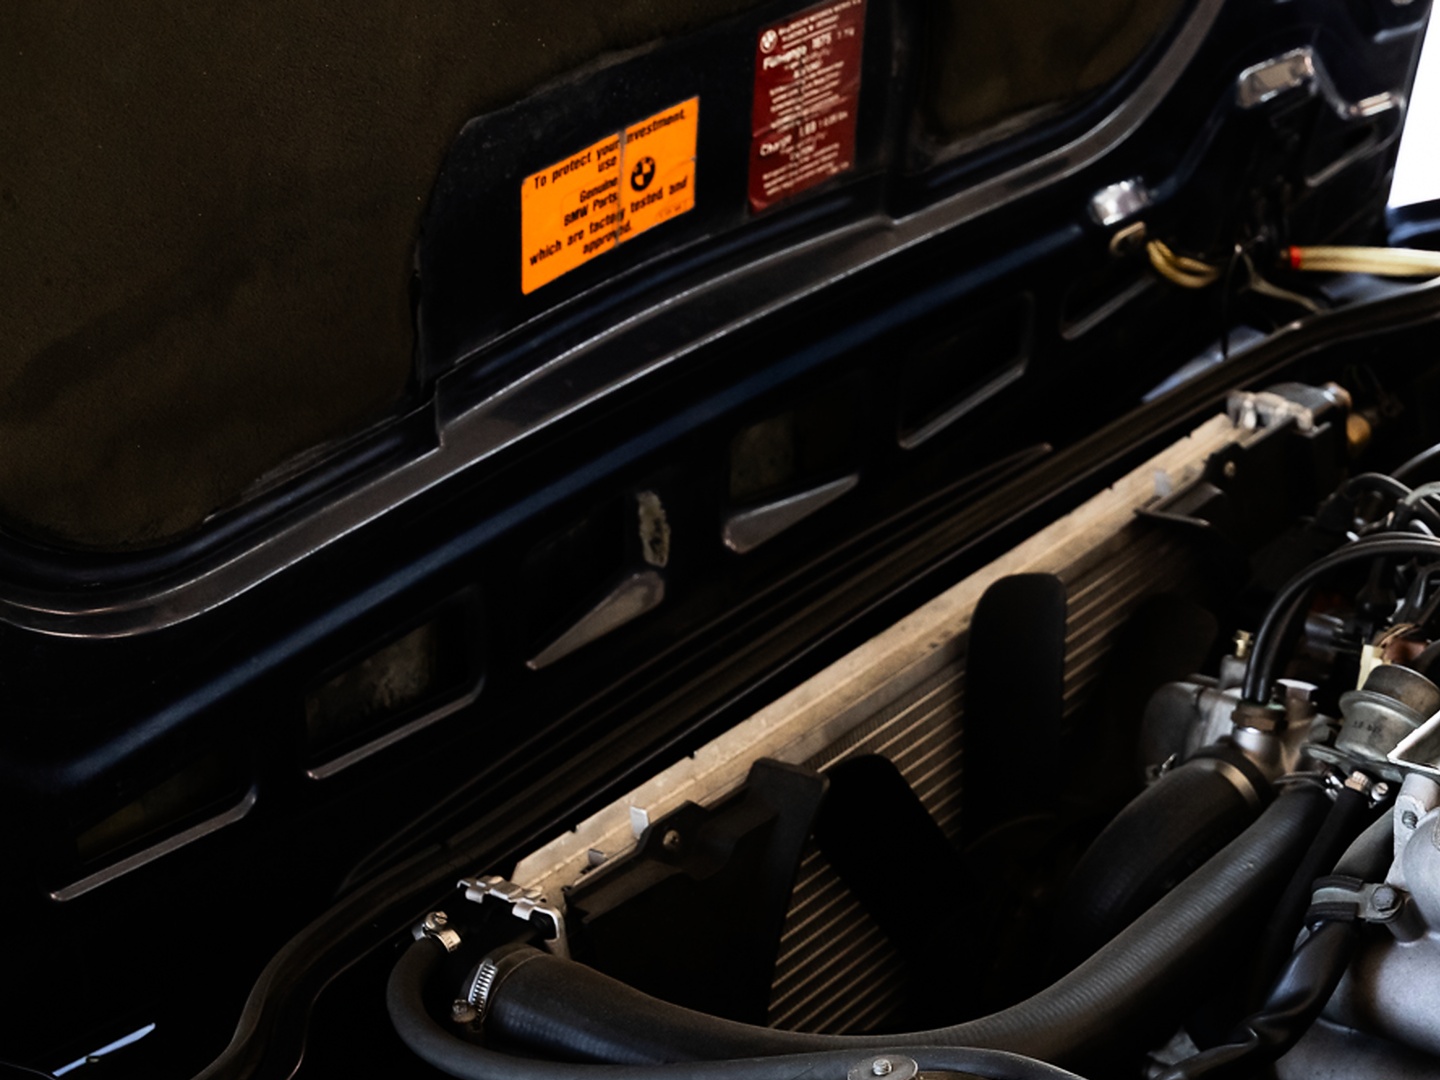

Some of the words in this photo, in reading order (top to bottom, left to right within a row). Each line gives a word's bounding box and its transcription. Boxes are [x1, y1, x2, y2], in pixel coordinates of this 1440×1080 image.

[535, 175, 546, 189] To
[552, 152, 592, 183] protect
[596, 140, 619, 160] your
[598, 155, 617, 172] use
[580, 177, 618, 203] Genuine
[530, 240, 562, 266] which
[567, 230, 584, 246] are
[630, 187, 663, 214] tested
[668, 175, 688, 195] and
[564, 204, 588, 226] BMW
